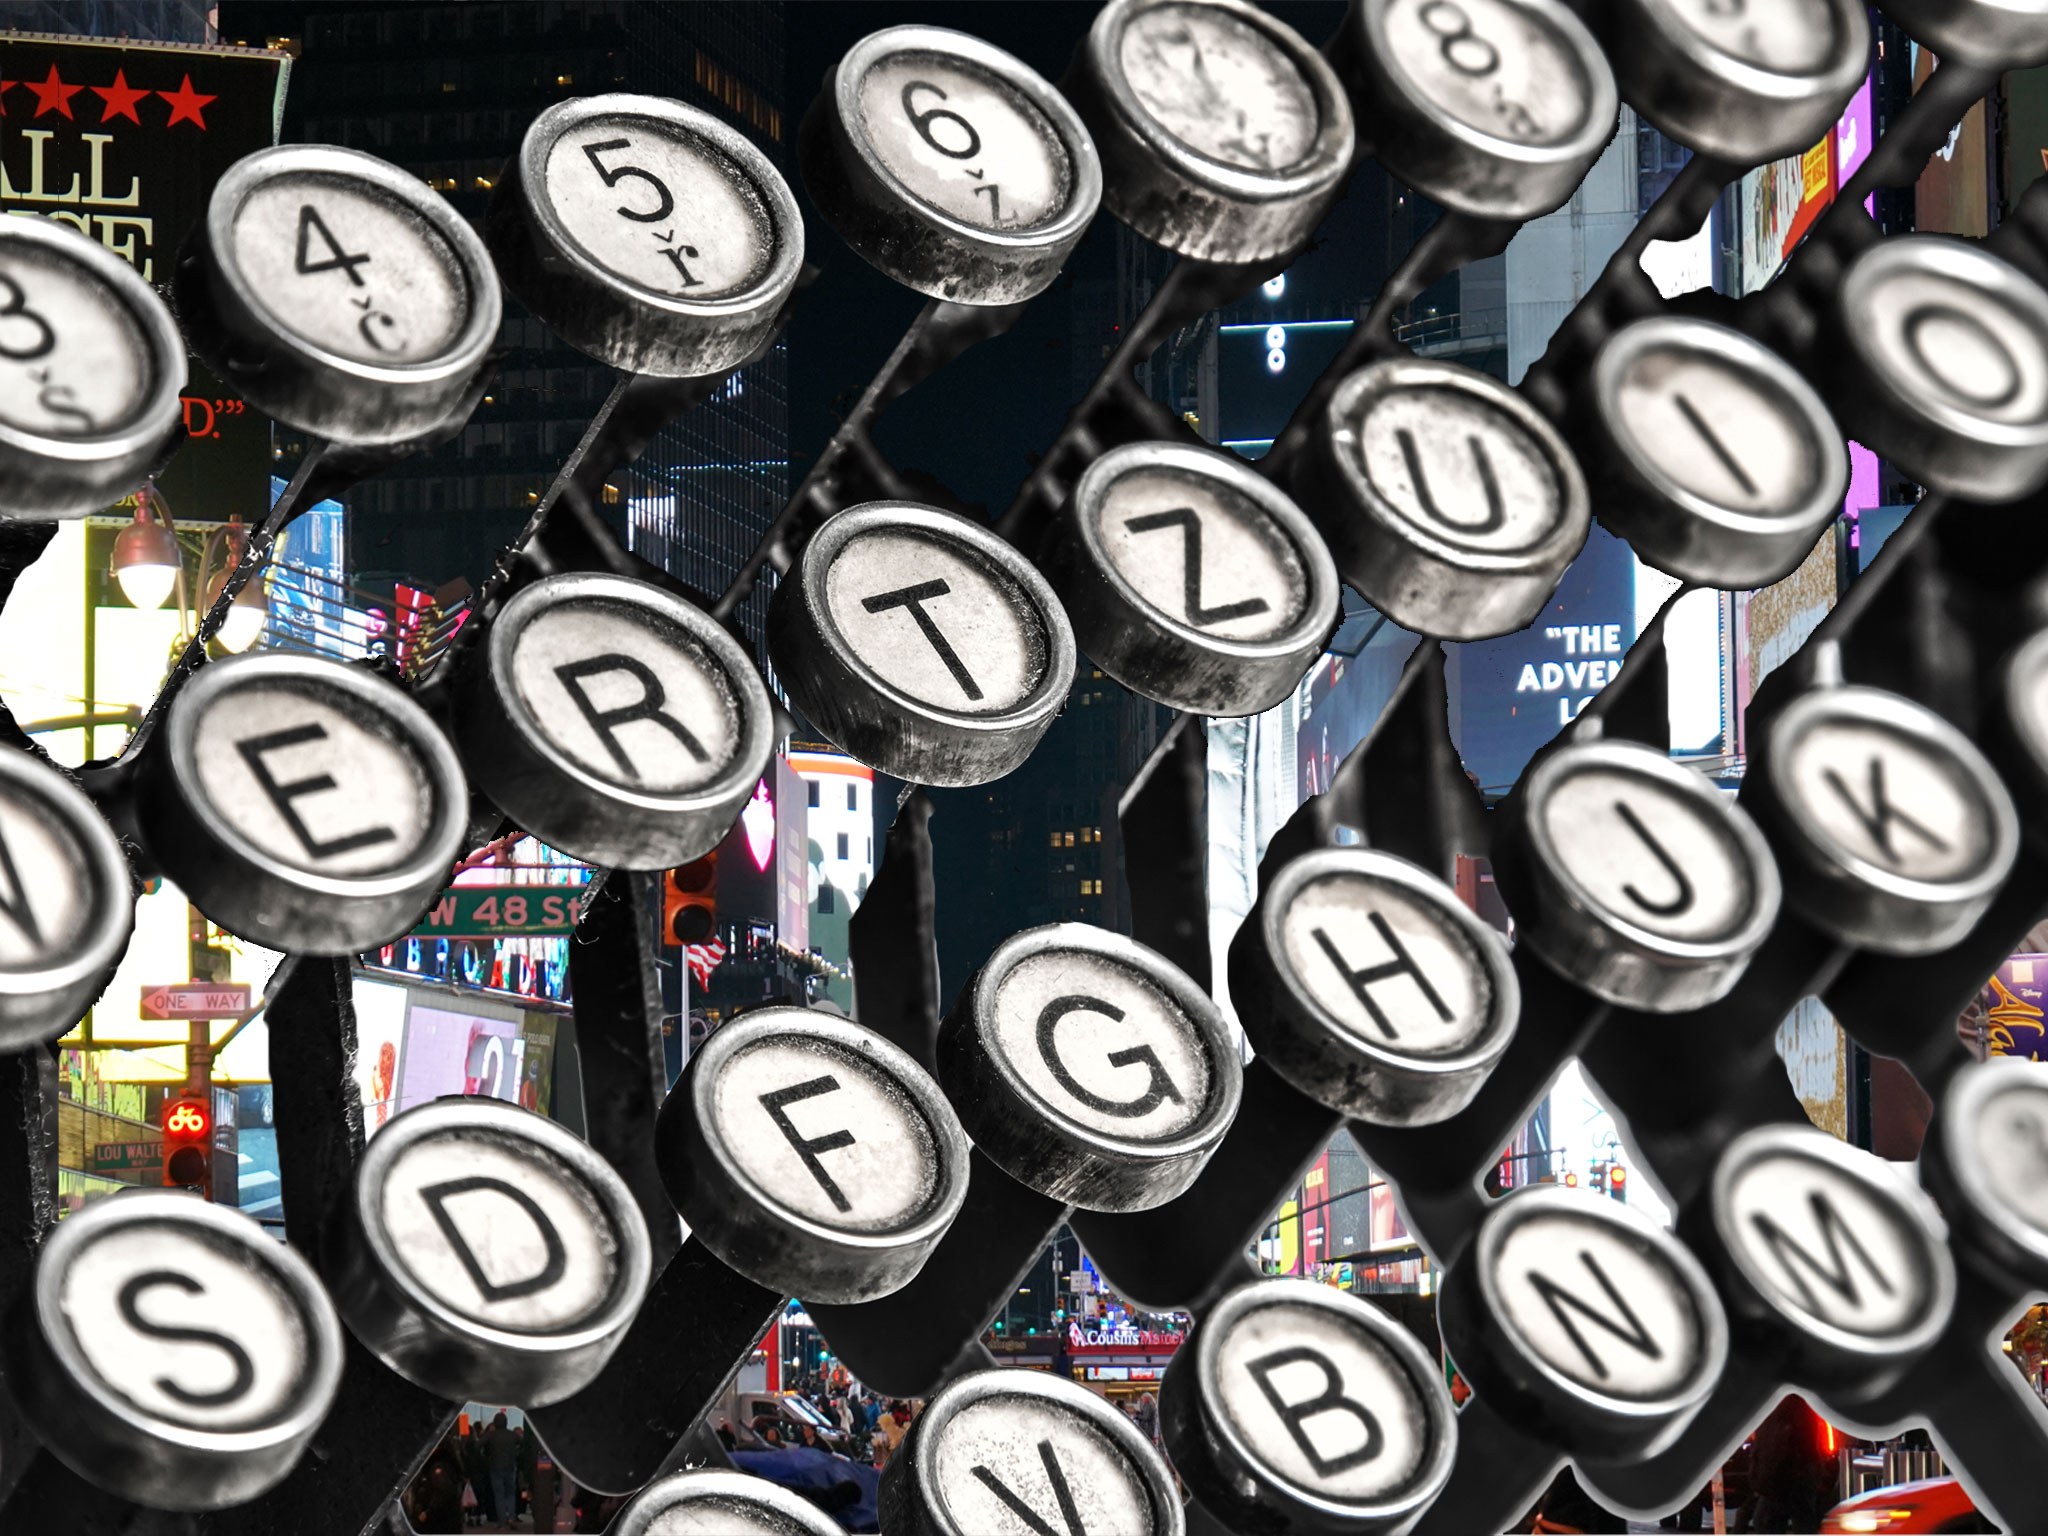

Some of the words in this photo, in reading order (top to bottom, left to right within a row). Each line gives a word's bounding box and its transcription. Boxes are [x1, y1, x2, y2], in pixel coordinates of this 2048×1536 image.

[582, 138, 674, 223] 5
[900, 80, 982, 161] 6
[295, 205, 371, 287] 4
[1394, 429, 1507, 535] U
[1123, 507, 1270, 627] Z
[861, 578, 984, 702] T
[554, 653, 711, 779] R
[236, 724, 397, 860] E
[1821, 757, 1953, 865] K
[429, 896, 457, 927] W
[472, 895, 528, 926] 48
[541, 896, 582, 926] St
[1614, 801, 1694, 918] J
[154, 994, 187, 1009] ONE
[205, 994, 241, 1009] WAY
[1312, 911, 1456, 1040] H
[1035, 995, 1187, 1118] G
[97, 1145, 121, 1160] LOU
[758, 1075, 857, 1213] F
[419, 1176, 567, 1303] D
[1751, 1191, 1898, 1310] M
[118, 1271, 255, 1408] S
[1527, 1250, 1664, 1380] N
[1245, 1347, 1384, 1479] B
